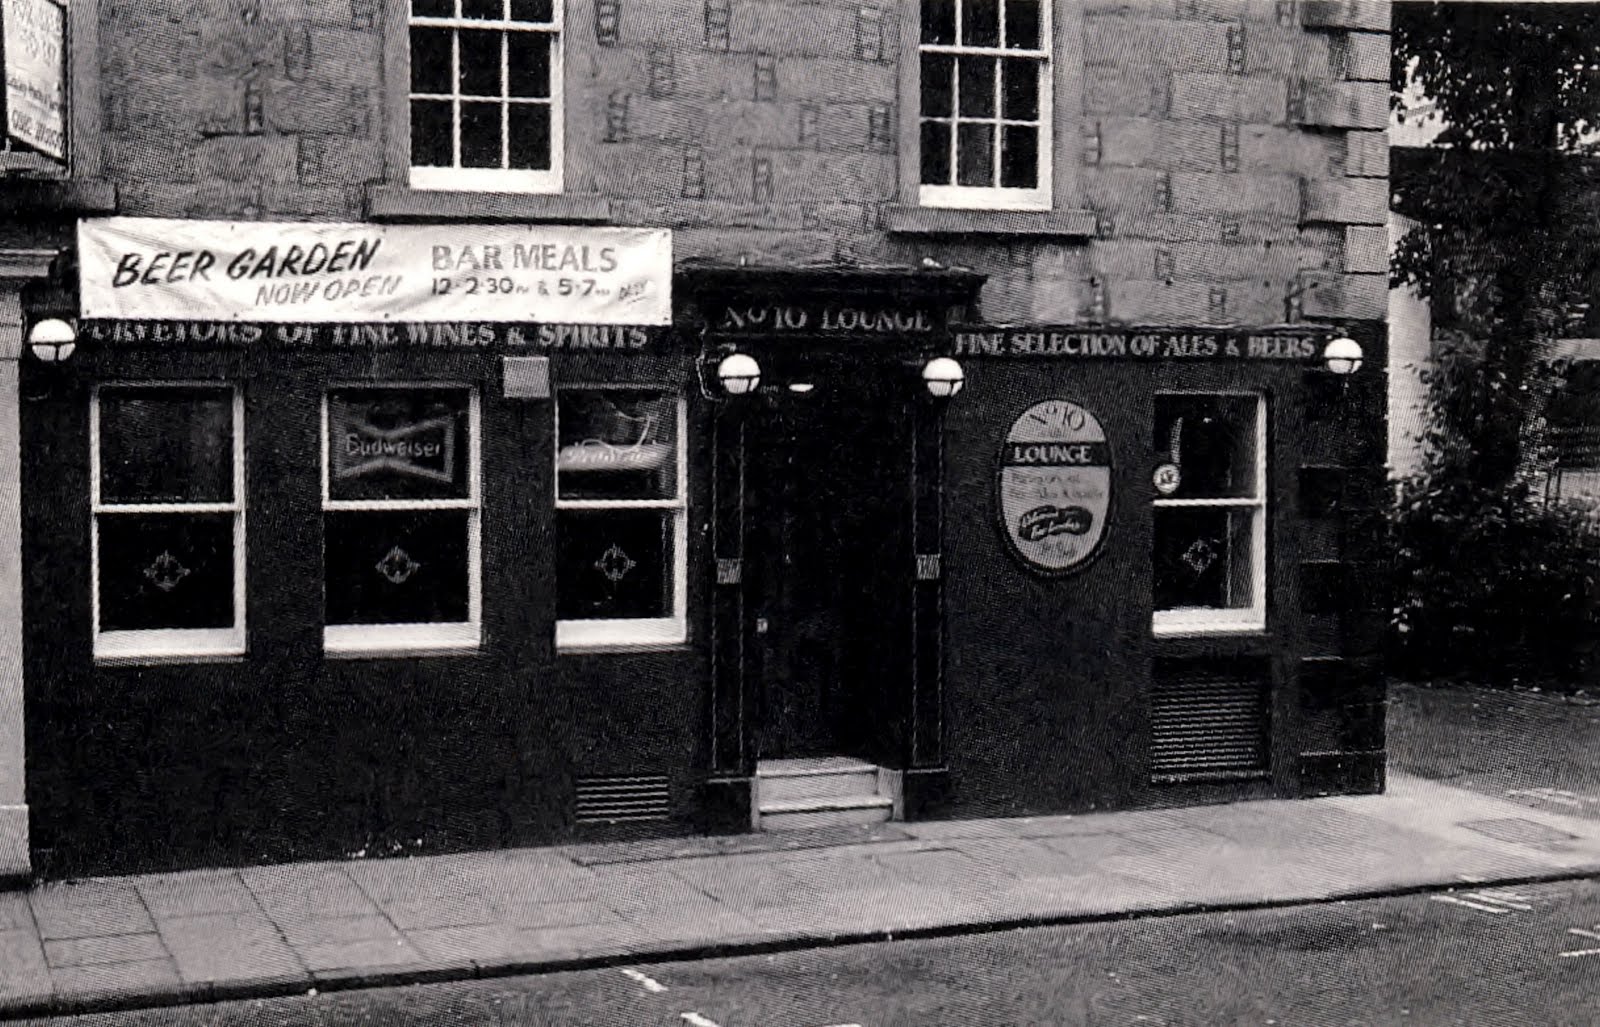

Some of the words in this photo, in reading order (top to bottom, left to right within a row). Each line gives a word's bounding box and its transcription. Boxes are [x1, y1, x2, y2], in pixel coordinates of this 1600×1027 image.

[112, 249, 216, 288] BEER
[226, 238, 381, 281] GARDEN
[431, 243, 505, 272] BAR
[512, 243, 619, 273] MEALS
[255, 281, 320, 306] NOW
[323, 275, 403, 301] OPEN
[81, 322, 263, 343] URVEYORS
[407, 324, 496, 346] WINES
[507, 326, 526, 346] &
[538, 324, 648, 348] SPIRITS
[954, 333, 1005, 355] FINE
[1010, 333, 1126, 356] SELECTION
[1130, 335, 1160, 356] OF
[1163, 335, 1217, 357] ALES
[1225, 338, 1240, 357] &
[1248, 335, 1315, 358] BEERS
[344, 433, 440, 457] Budweiser
[1013, 445, 1092, 463] LOUNGE
